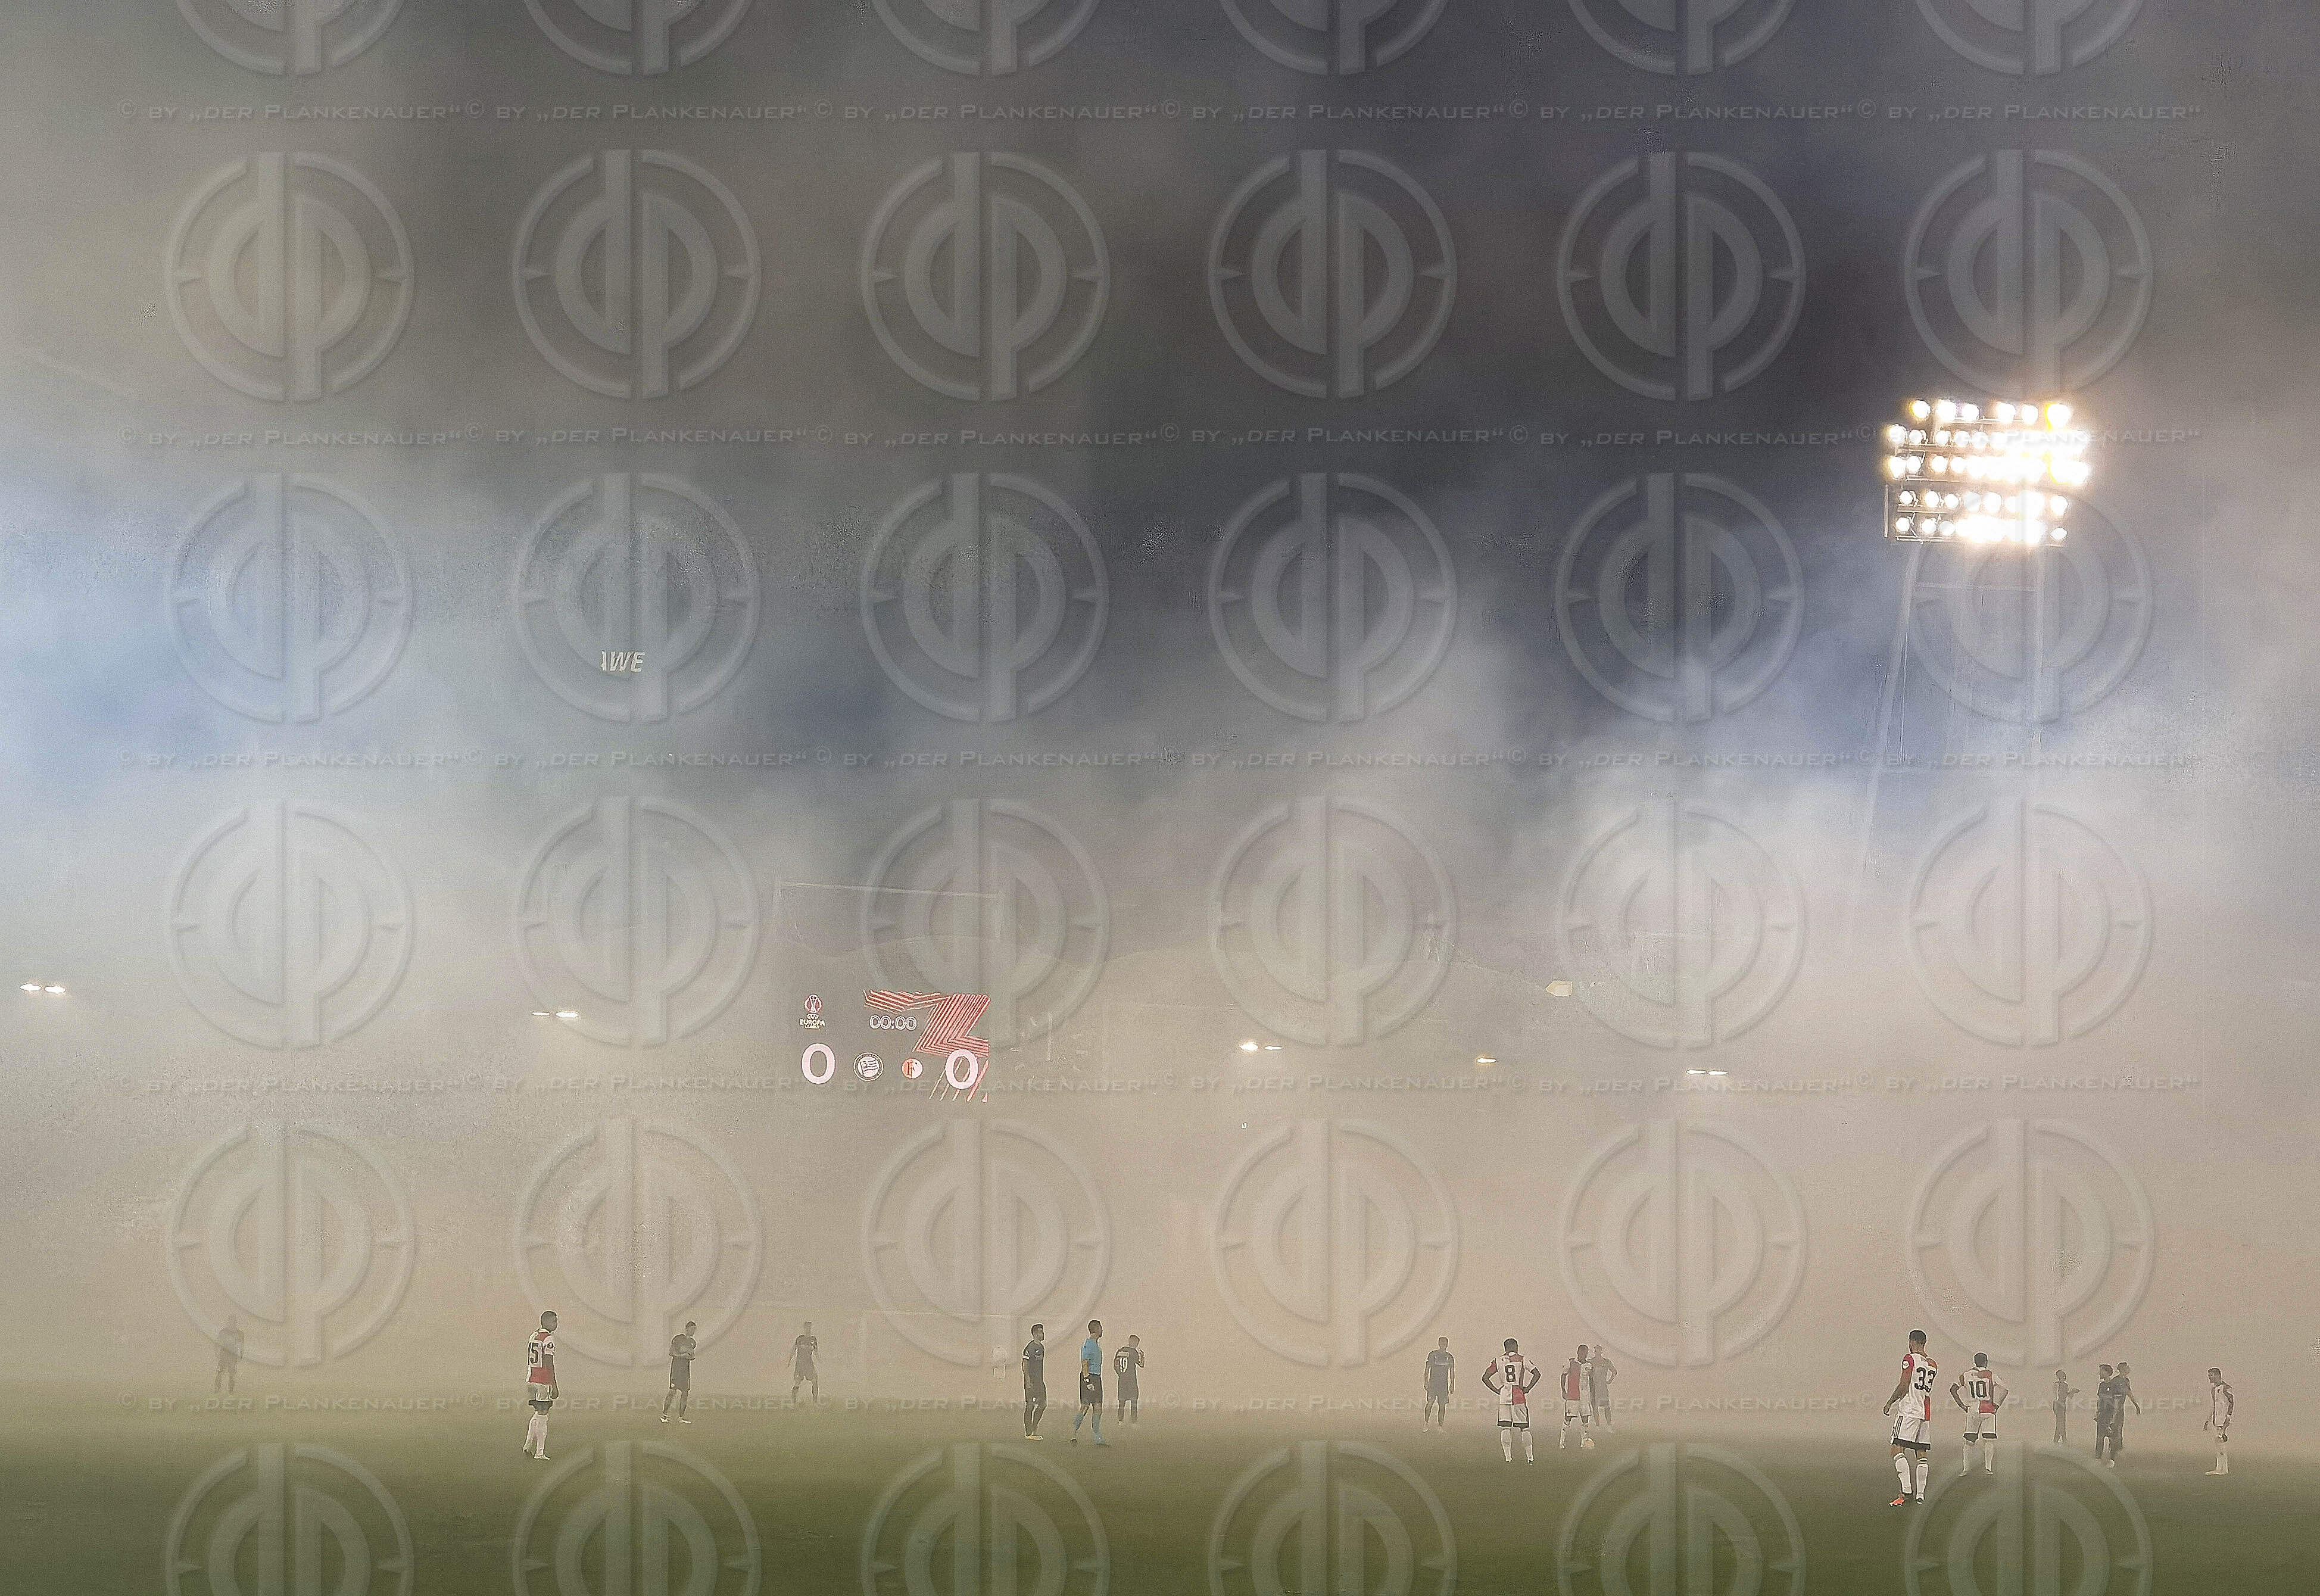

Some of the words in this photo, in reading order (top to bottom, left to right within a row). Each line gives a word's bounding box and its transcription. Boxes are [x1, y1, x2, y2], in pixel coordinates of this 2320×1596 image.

[869, 1015, 916, 1030] 00:00
[802, 1043, 836, 1084] 0
[945, 1049, 978, 1089] 0
[1505, 1364, 1516, 1382] 8
[1914, 1367, 1935, 1393] 33
[1969, 1380, 1987, 1398] 10
